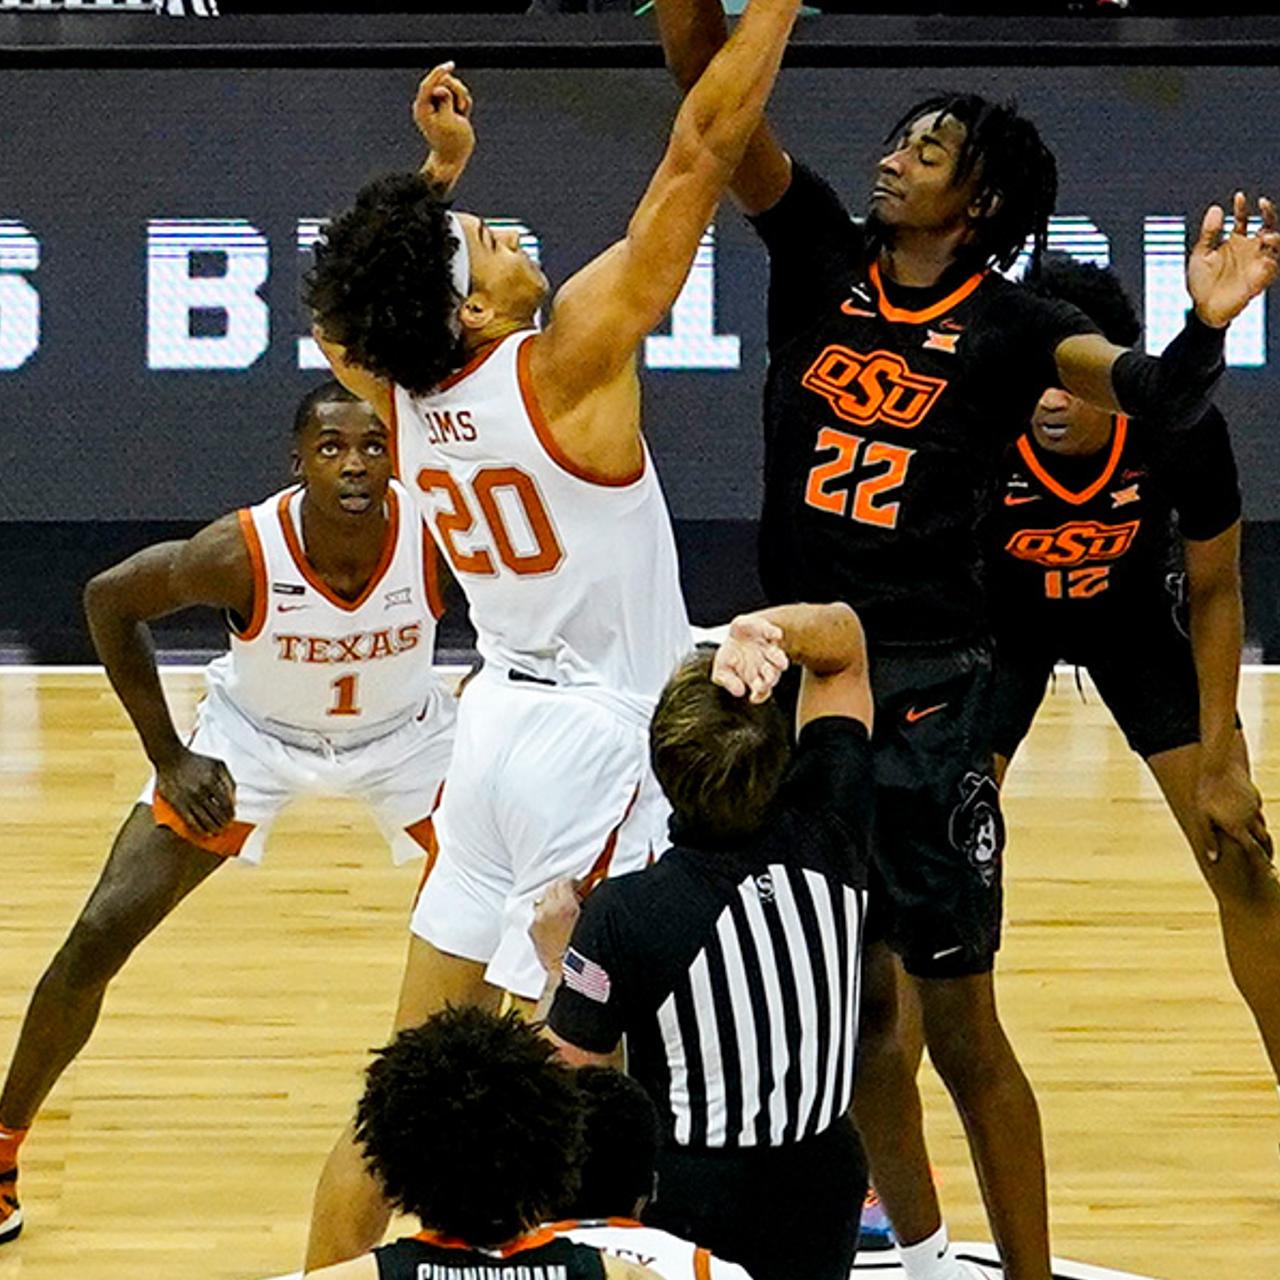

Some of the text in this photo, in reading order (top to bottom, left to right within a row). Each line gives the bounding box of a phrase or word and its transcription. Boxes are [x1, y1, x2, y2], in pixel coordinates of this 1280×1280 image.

[802, 343, 948, 428] OSU
[804, 426, 918, 529] 22
[416, 465, 565, 577] 20
[1004, 520, 1141, 566] OSU
[1045, 567, 1111, 599] 12
[273, 622, 421, 663] TEXAS
[326, 673, 360, 716] 1
